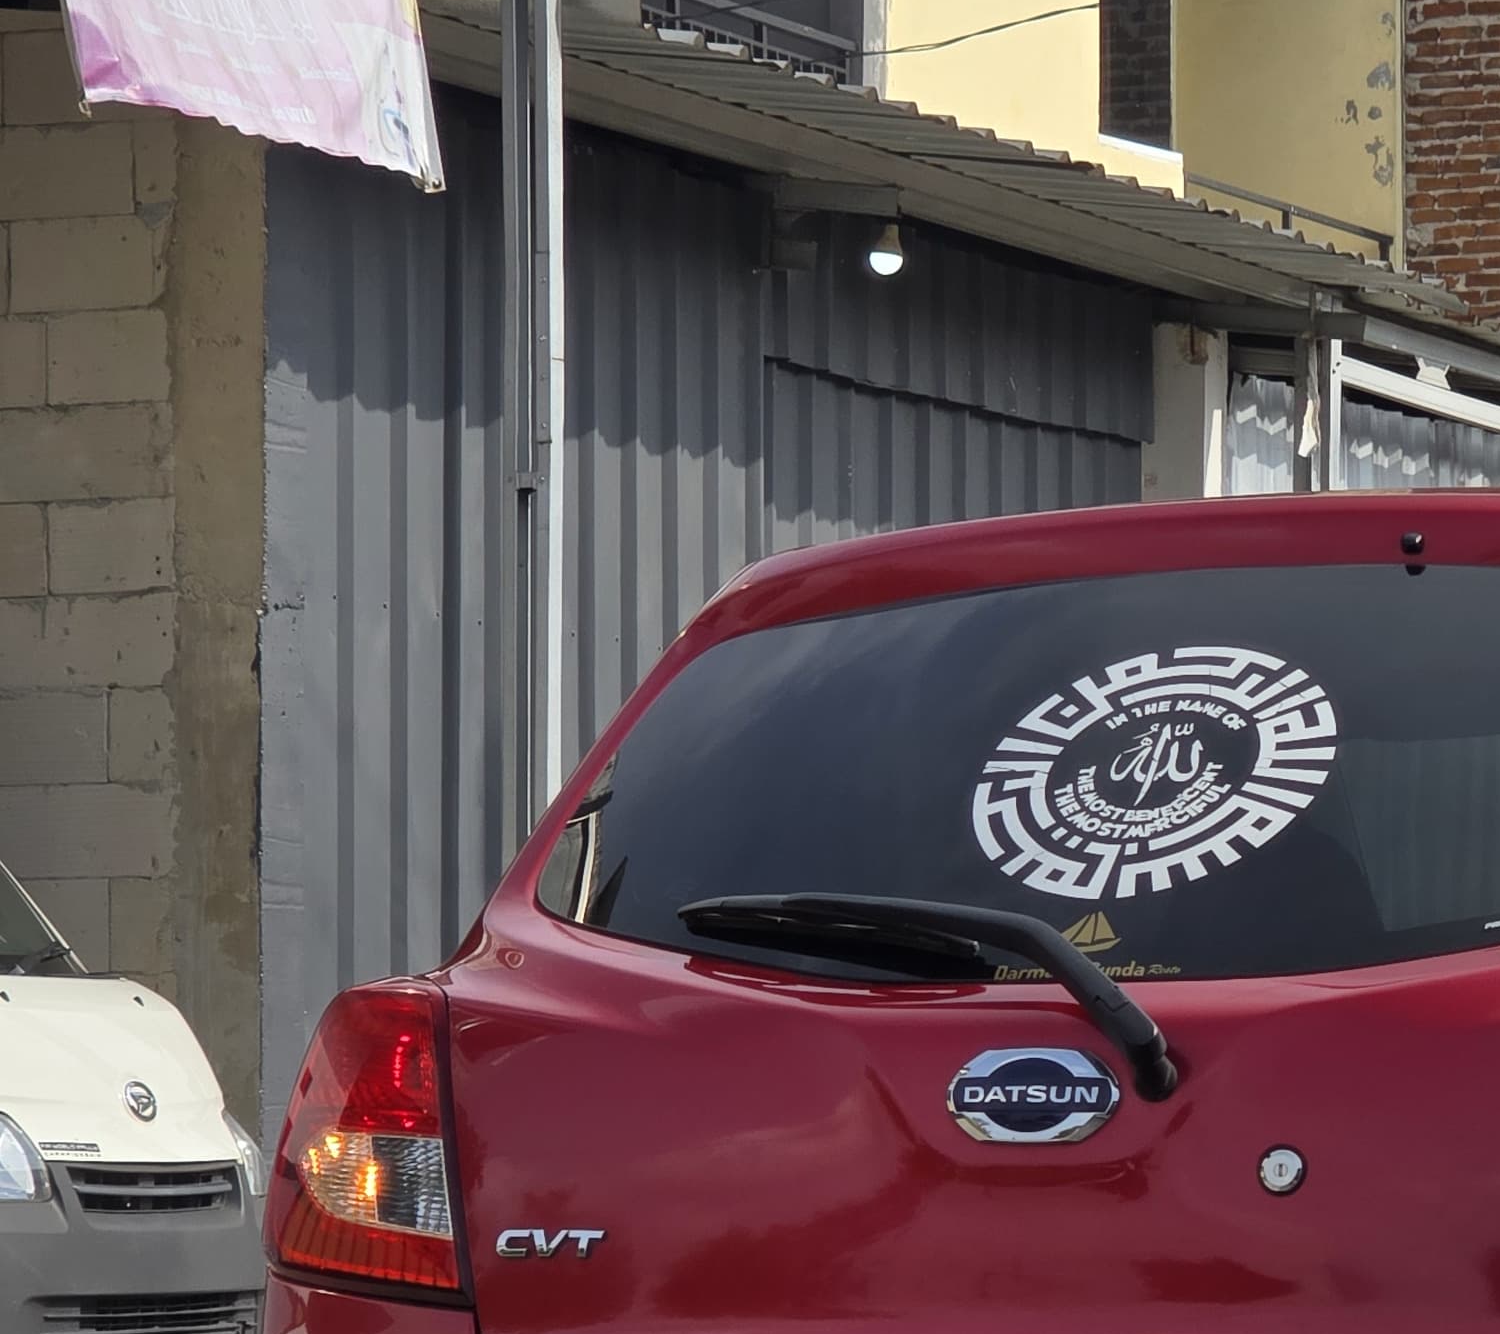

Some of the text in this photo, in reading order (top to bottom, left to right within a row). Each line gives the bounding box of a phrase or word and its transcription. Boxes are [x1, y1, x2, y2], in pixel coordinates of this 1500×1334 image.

[1105, 699, 1248, 731] IN THE NAME OF
[1054, 782, 1081, 818] THE
[1077, 761, 1224, 822] THE MOST BENEFICENT
[1067, 811, 1128, 839] MOST
[963, 1085, 1100, 1104] DATSUN
[496, 1229, 606, 1257] CVT
